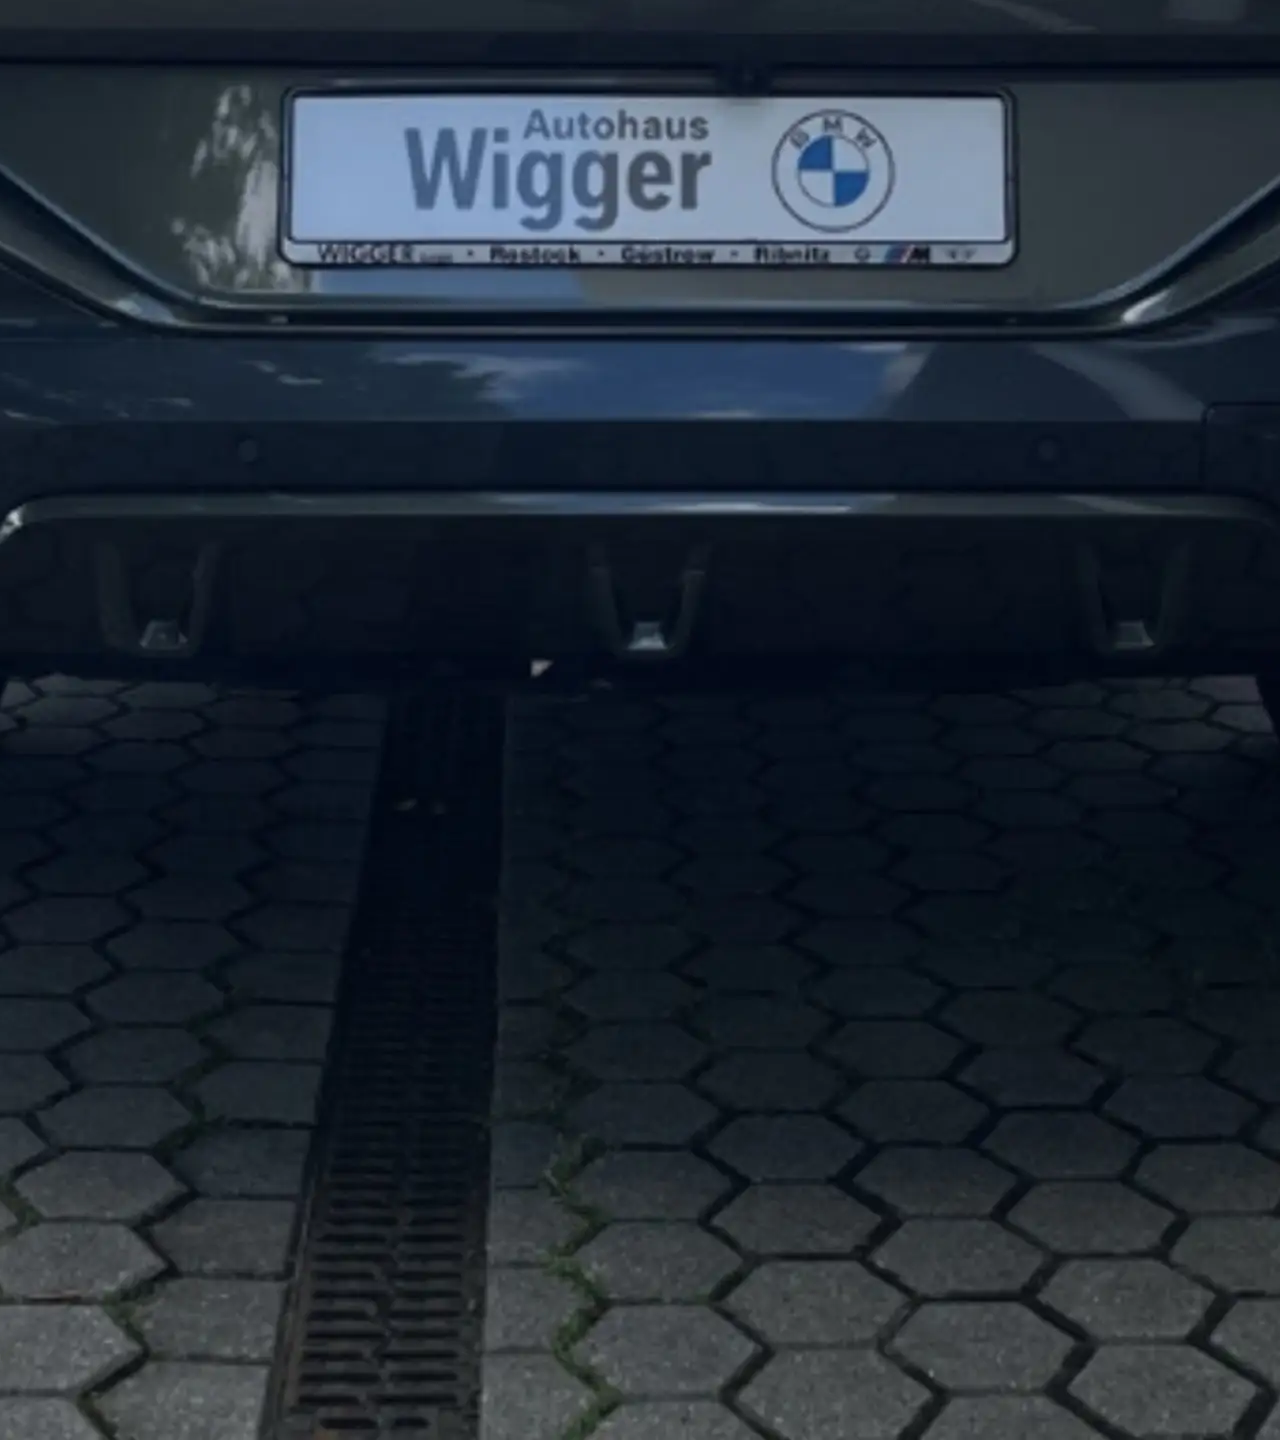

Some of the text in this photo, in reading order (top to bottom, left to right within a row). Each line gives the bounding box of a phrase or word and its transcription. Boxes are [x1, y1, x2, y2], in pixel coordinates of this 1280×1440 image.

[523, 108, 709, 140] Autohaus
[404, 125, 713, 233] Wigger
[317, 244, 415, 264] WIGGER
[489, 243, 581, 264] Rostock
[753, 243, 830, 264] Ribnitz
